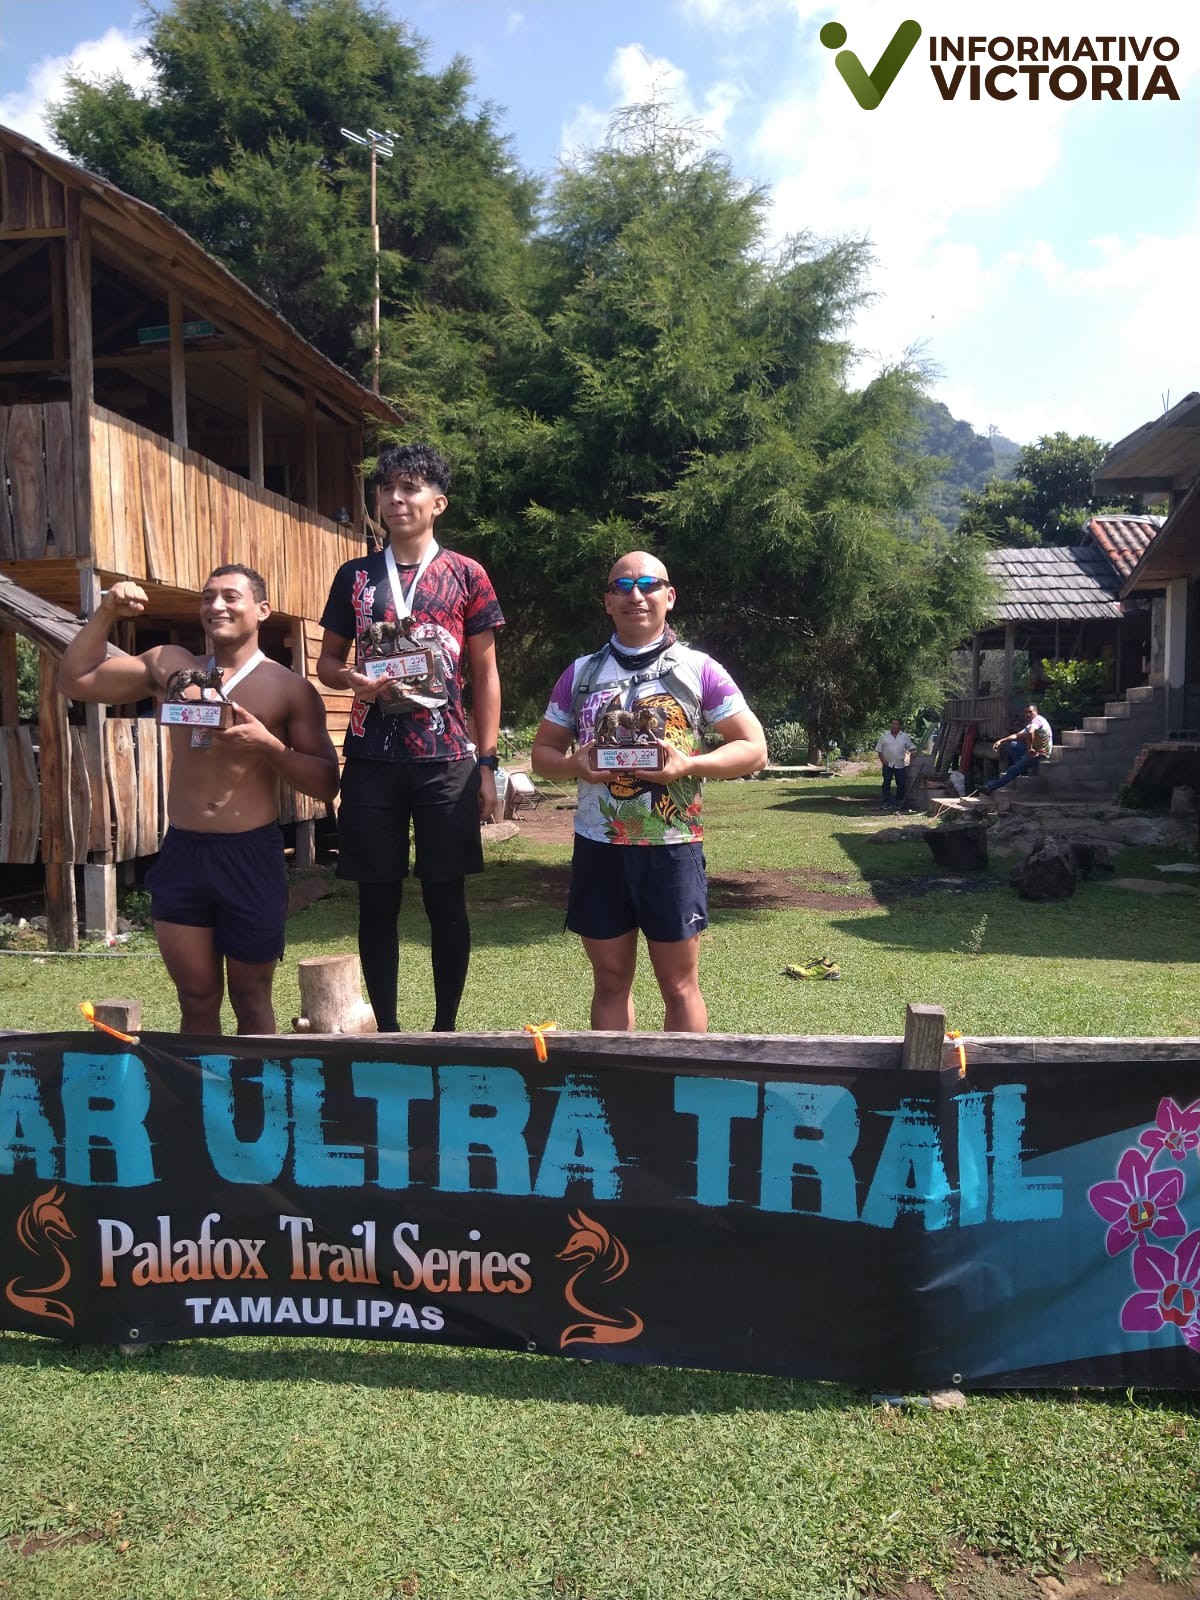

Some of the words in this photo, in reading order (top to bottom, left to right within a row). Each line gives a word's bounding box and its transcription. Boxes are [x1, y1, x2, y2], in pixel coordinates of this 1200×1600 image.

[400, 659, 408, 675] 1
[410, 656, 425, 665] 22K
[631, 751, 638, 766] 2
[184, 1053, 638, 1201] ULTRA
[674, 1075, 1064, 1231] TRAIL
[98, 1213, 268, 1288] Palafox
[280, 1214, 379, 1286] Trail
[393, 1222, 532, 1294] Series
[185, 1296, 445, 1331] TAMAULIPAS
